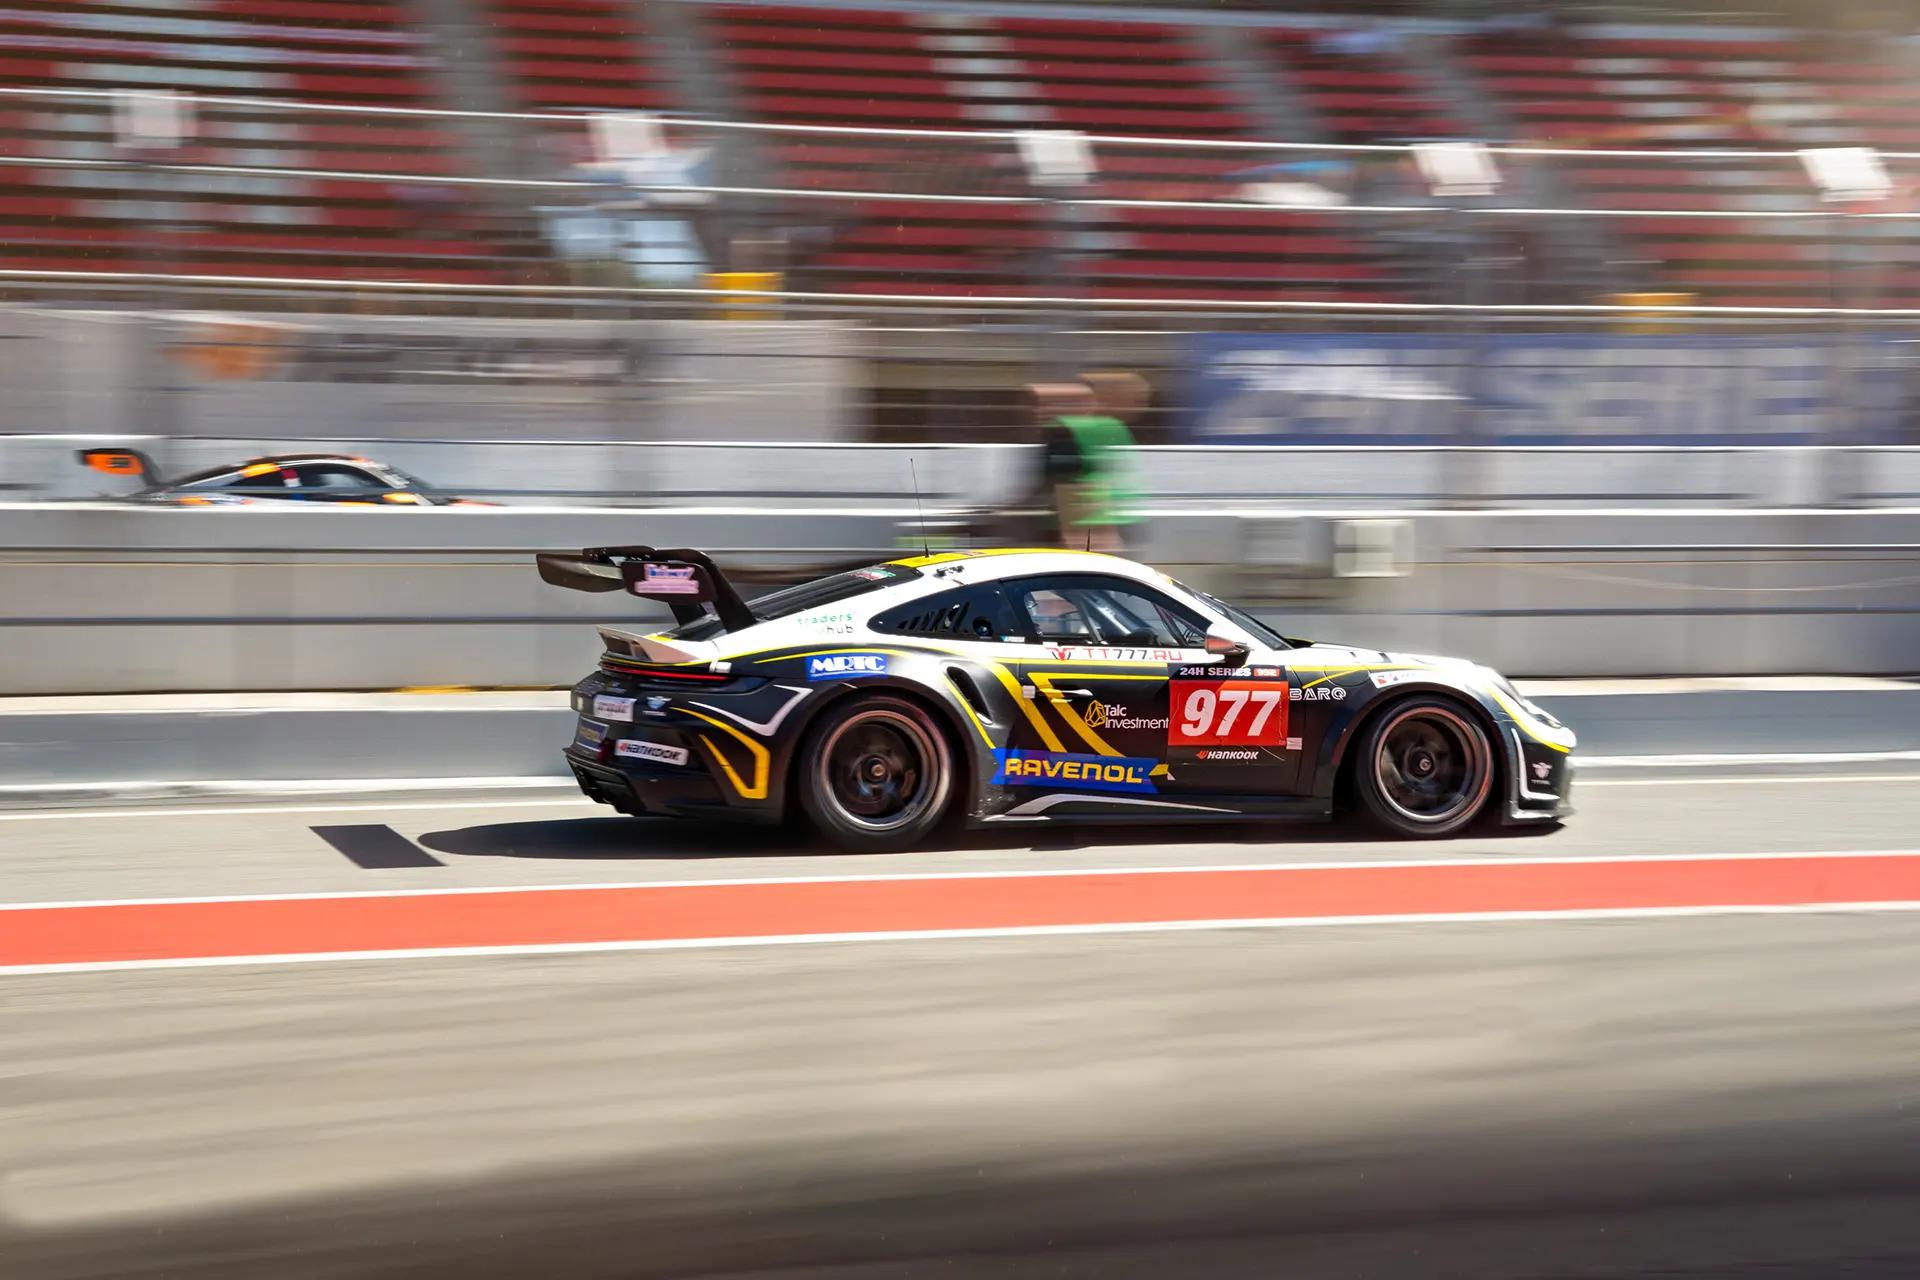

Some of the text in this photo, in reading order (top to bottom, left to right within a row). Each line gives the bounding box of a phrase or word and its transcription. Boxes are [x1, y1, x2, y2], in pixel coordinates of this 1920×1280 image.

[797, 613, 853, 625] traders
[827, 625, 853, 634] hub
[1083, 648, 1183, 661] TT777.RU
[1180, 667, 1204, 676] 24H
[1208, 667, 1252, 677] SERIES
[1288, 687, 1347, 701] BARQ
[1104, 704, 1127, 717] Talc
[1181, 689, 1281, 737] 977
[1105, 717, 1169, 729] Investment
[1005, 758, 1143, 784] RAVENOL
